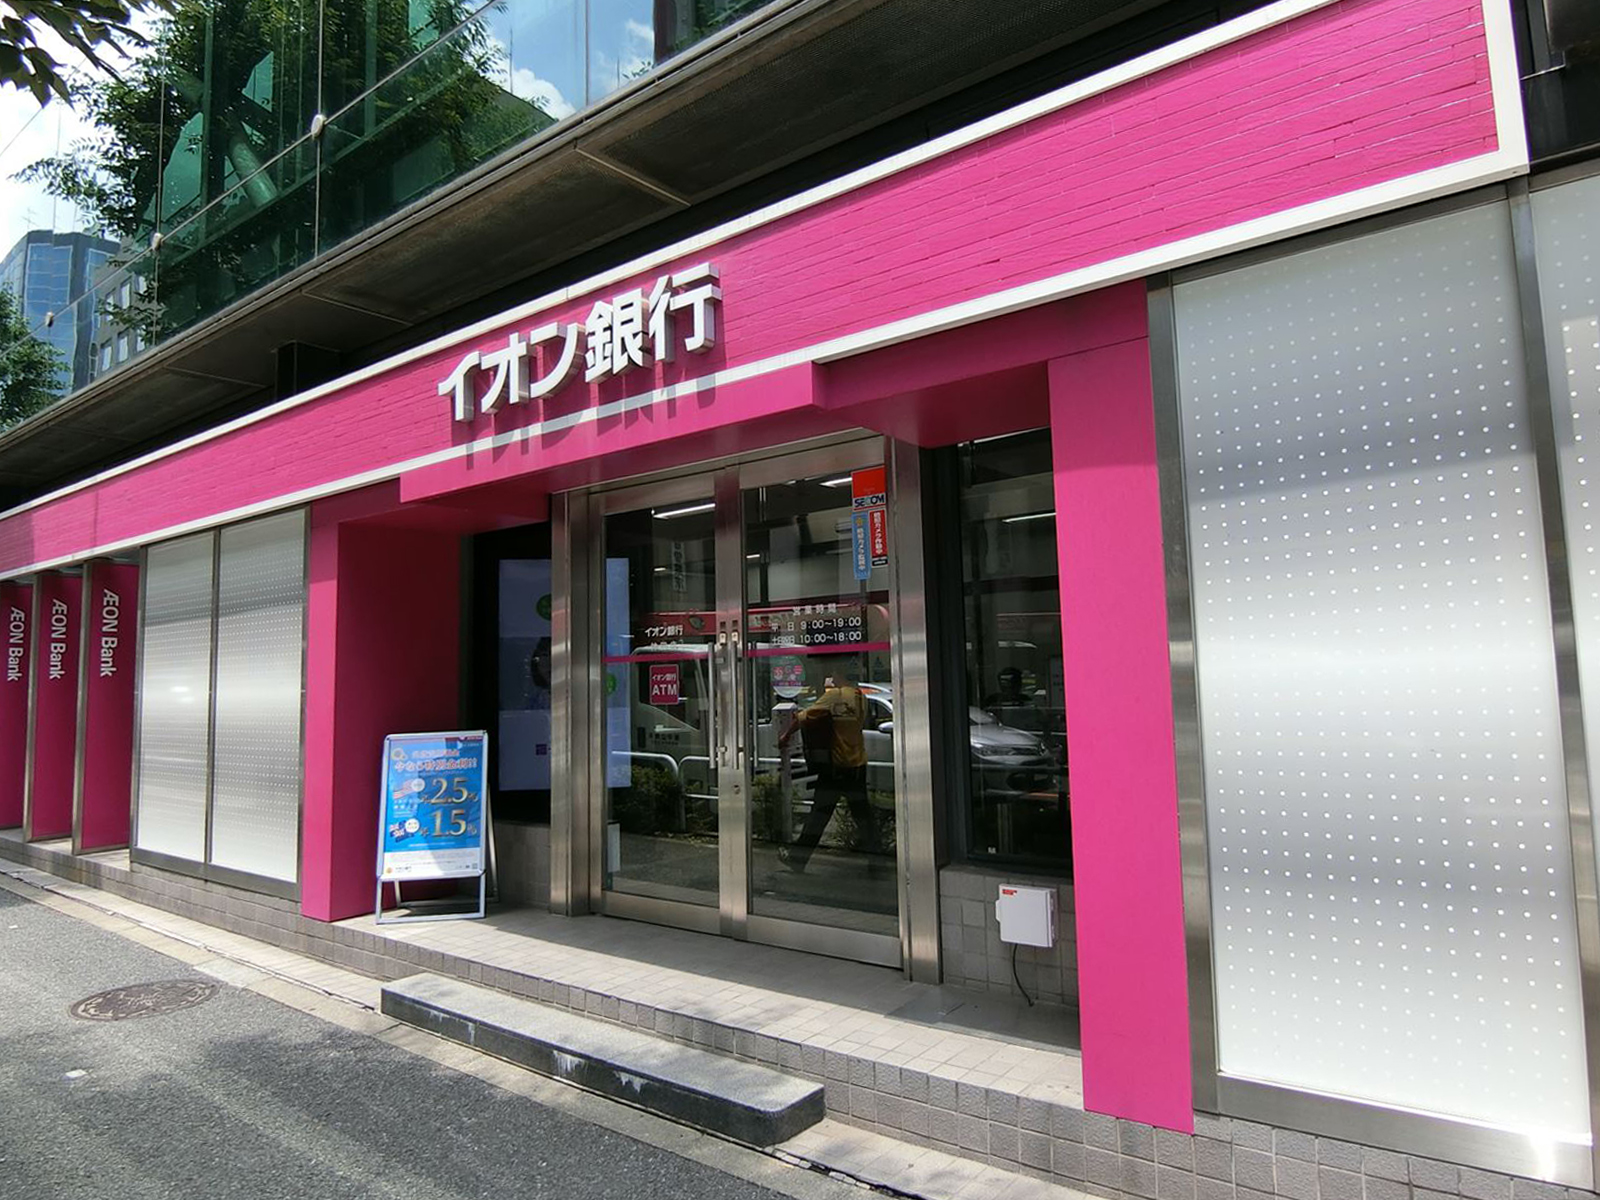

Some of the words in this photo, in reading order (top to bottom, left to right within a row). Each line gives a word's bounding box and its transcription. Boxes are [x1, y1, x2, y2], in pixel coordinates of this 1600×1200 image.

[438, 262, 721, 422] イオン銀行
[854, 494, 885, 508] SECOM
[792, 603, 837, 616] 営業時間
[644, 625, 683, 638] イオン銀行
[7, 647, 23, 681] Bank
[49, 643, 66, 680] Bank
[100, 637, 118, 677] Bank
[651, 673, 677, 682] イオン銀行
[651, 684, 678, 696] ATM
